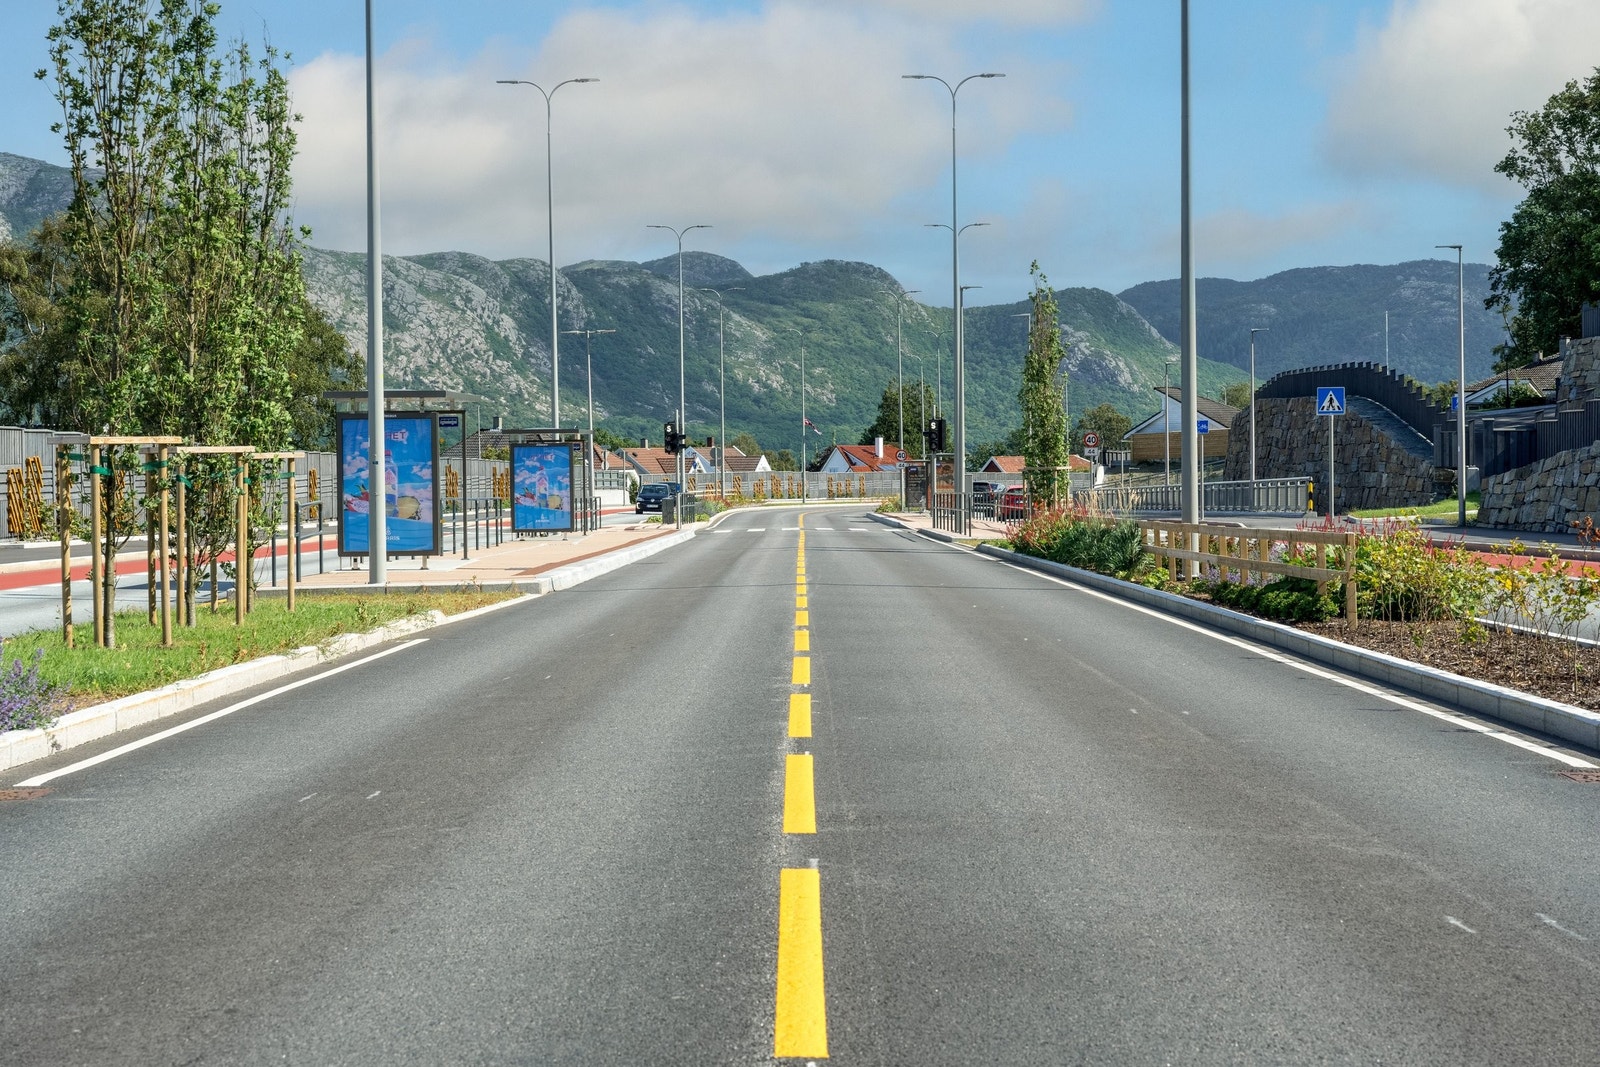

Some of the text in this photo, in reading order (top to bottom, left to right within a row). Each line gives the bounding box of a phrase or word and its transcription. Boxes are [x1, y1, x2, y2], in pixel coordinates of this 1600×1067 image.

[666, 425, 672, 433] S
[930, 421, 936, 430] S
[385, 431, 406, 440] HET
[1086, 436, 1096, 444] 40
